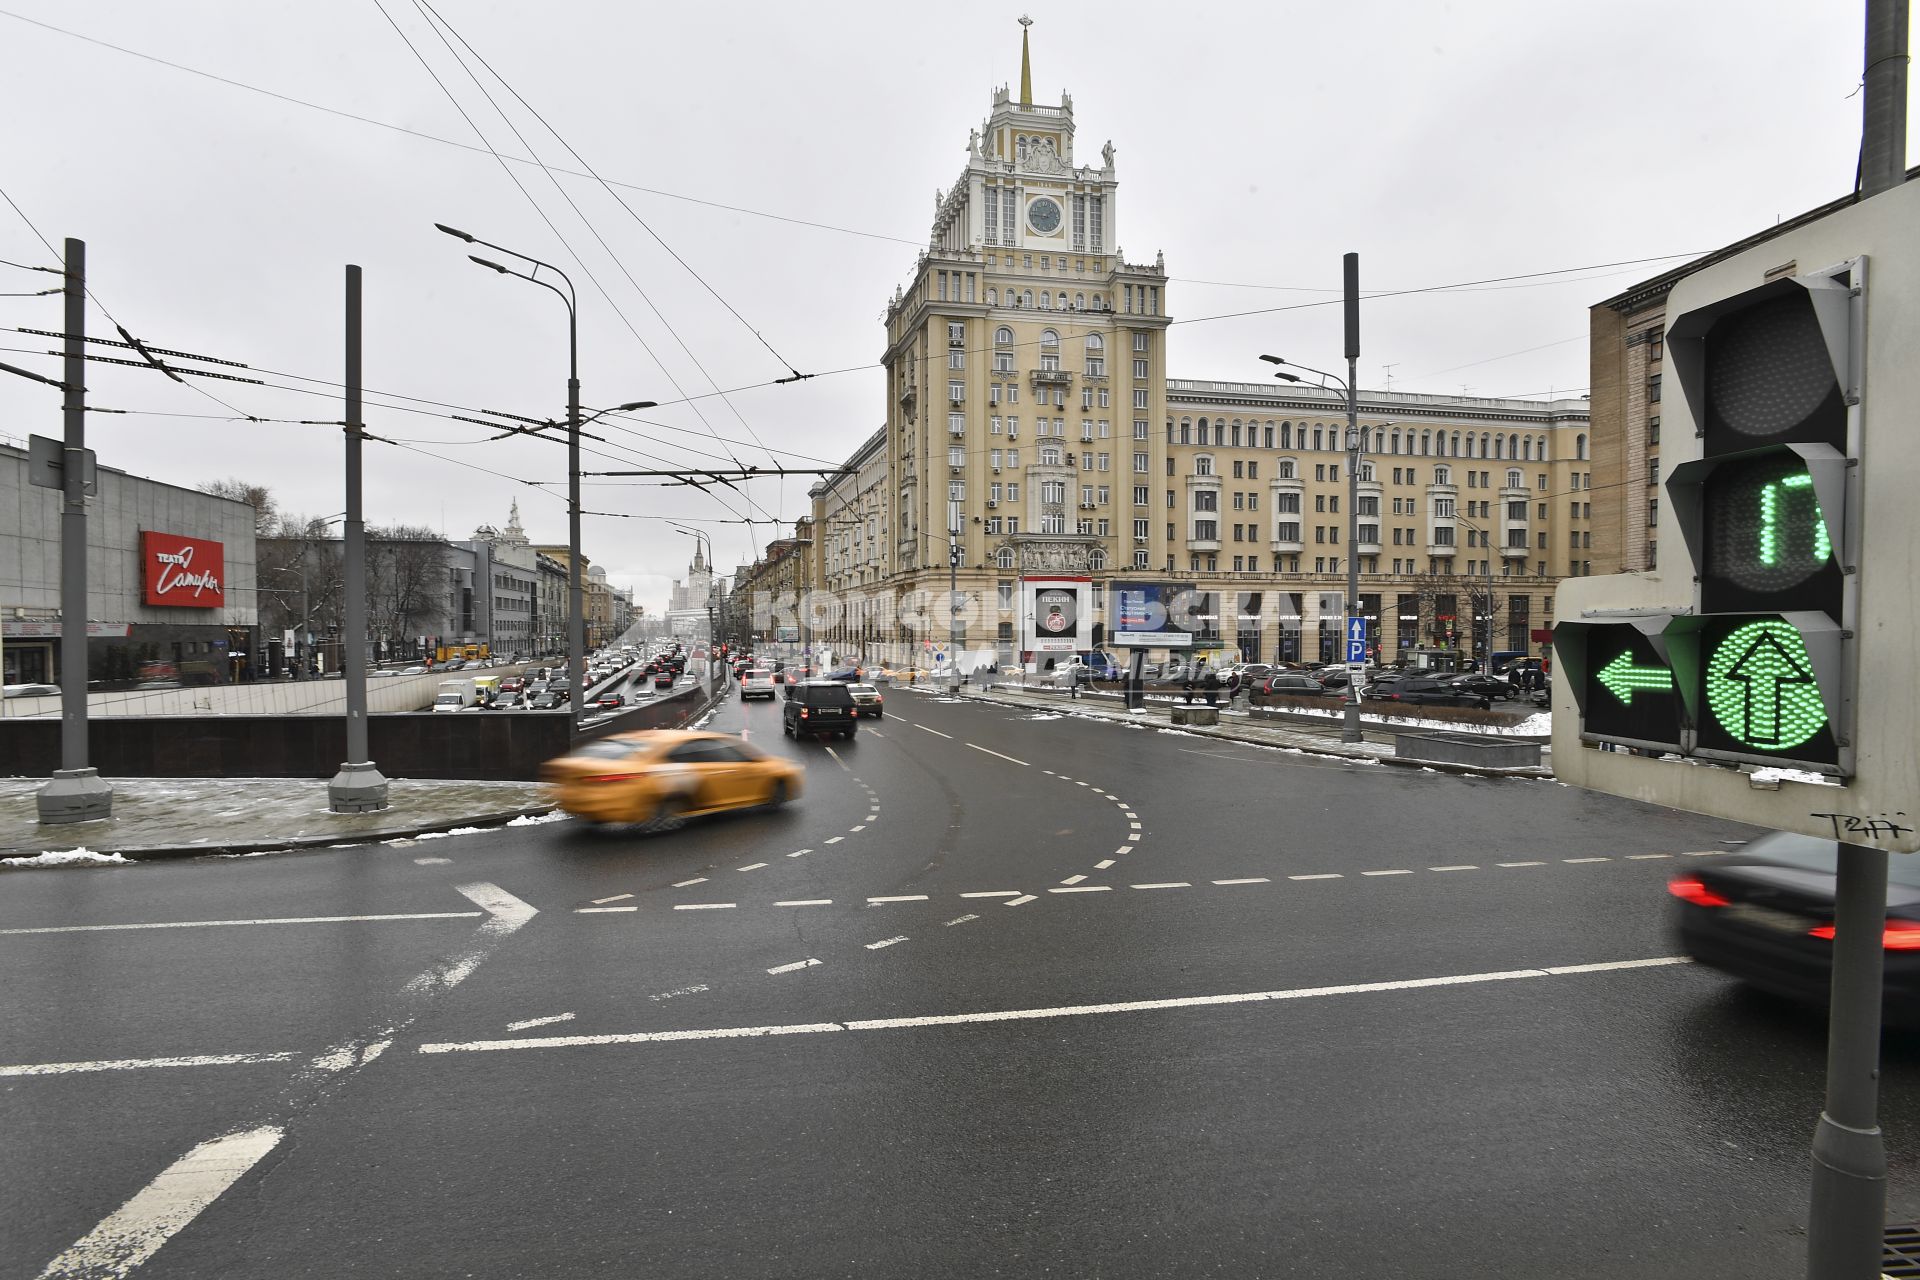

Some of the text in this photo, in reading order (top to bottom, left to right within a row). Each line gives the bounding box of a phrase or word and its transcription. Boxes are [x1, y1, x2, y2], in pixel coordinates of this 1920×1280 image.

[156, 553, 184, 564] ТЕАТР
[156, 546, 220, 598] Сатиры
[1351, 642, 1363, 661] P
